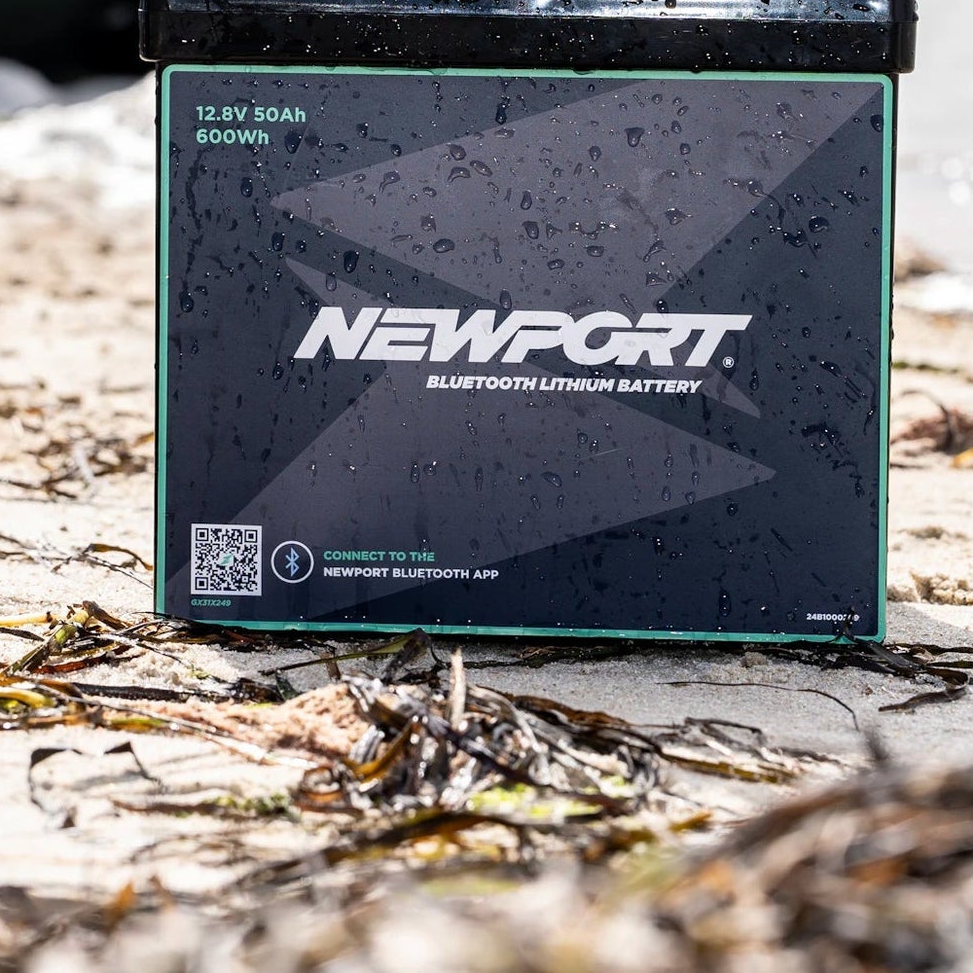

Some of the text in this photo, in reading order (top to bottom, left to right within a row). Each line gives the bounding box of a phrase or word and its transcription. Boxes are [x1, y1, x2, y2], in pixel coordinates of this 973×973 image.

[196, 106, 306, 122] 12.8V 50Ah
[196, 129, 269, 144] 600Wh
[293, 306, 753, 367] NEWPORT
[426, 375, 702, 394] BLUETOOTH LITHIUM BATTERY
[323, 550, 435, 562] CONNECT TO THE
[323, 567, 499, 580] NEWPORT BLUETOOTH APP
[191, 598, 232, 607] GX31X249
[806, 612, 860, 622] 24B10009
